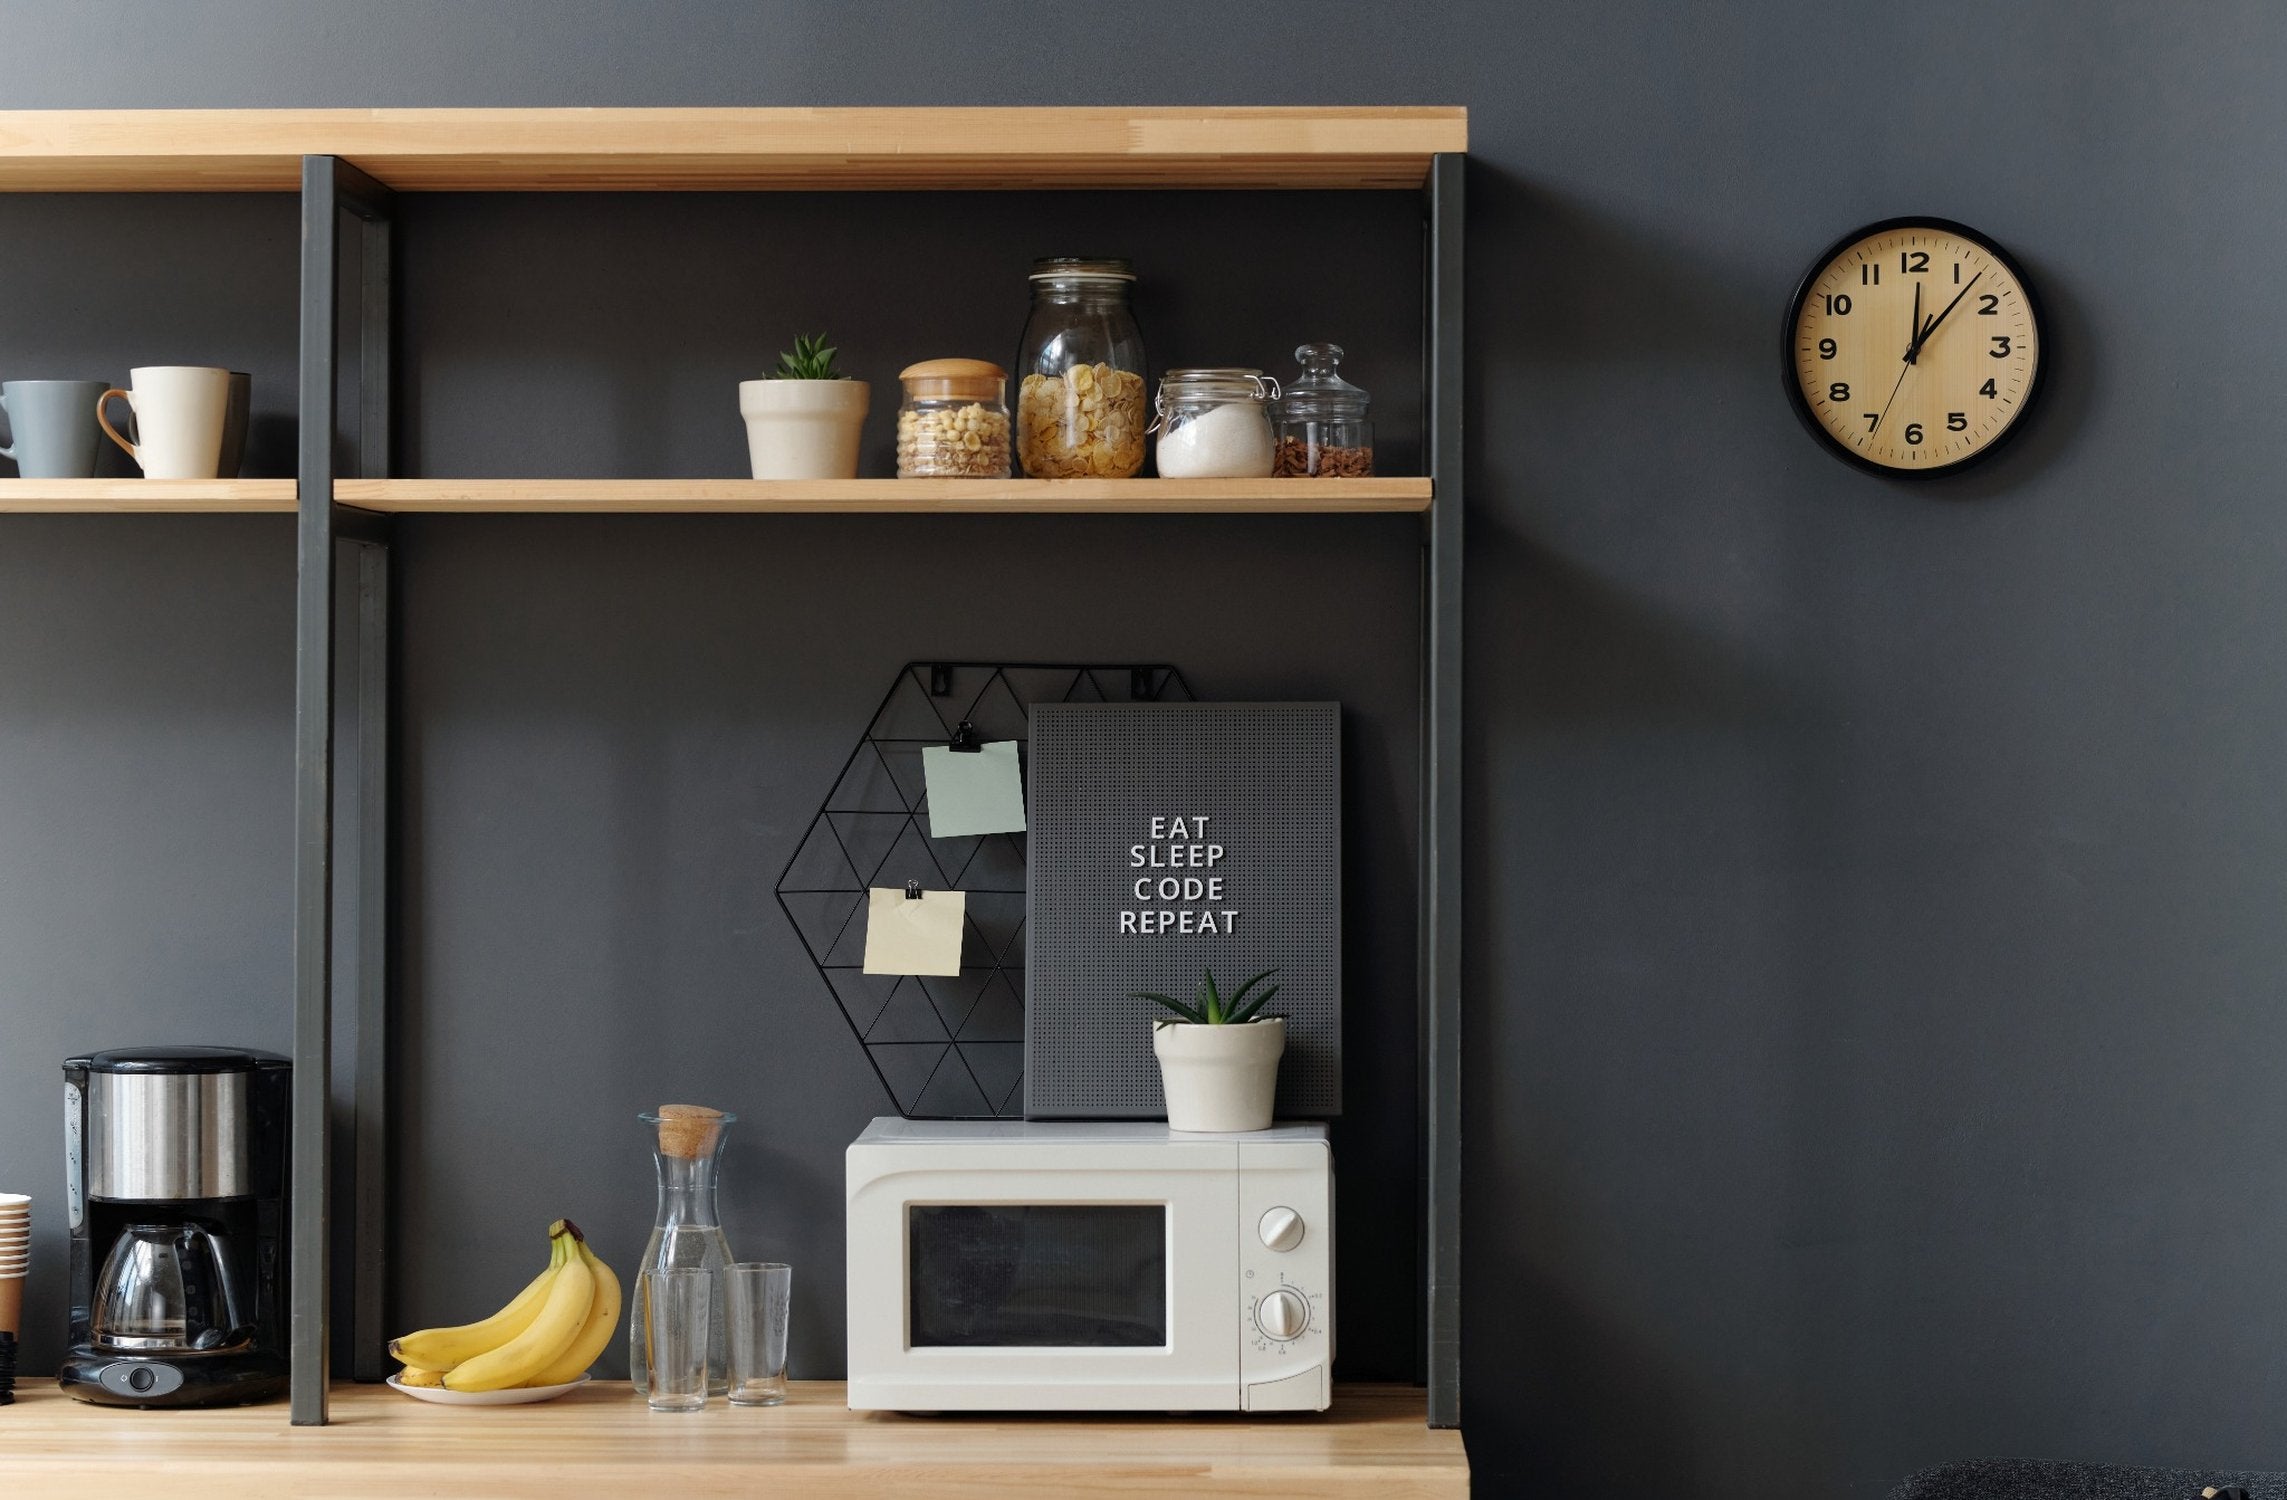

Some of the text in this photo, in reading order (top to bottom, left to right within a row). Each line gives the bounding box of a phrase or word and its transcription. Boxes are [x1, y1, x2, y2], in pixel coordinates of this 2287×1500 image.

[1862, 263, 1879, 285] 11
[1901, 252, 1930, 274] 12
[1954, 263, 1959, 284] 1
[1825, 294, 1852, 317] 10
[1978, 295, 1999, 315] 2
[1818, 338, 1837, 360] 9
[1989, 336, 2010, 358] 3
[1829, 382, 1850, 402] 8
[1979, 378, 1997, 399] 4
[1863, 414, 1879, 433] 7
[1947, 412, 1967, 431] 5
[1905, 423, 1923, 445] 6
[1152, 817, 1209, 839] EAT
[1131, 845, 1223, 867] SLEEP
[1135, 878, 1222, 900] CODE
[1121, 911, 1238, 934] REPEAT
